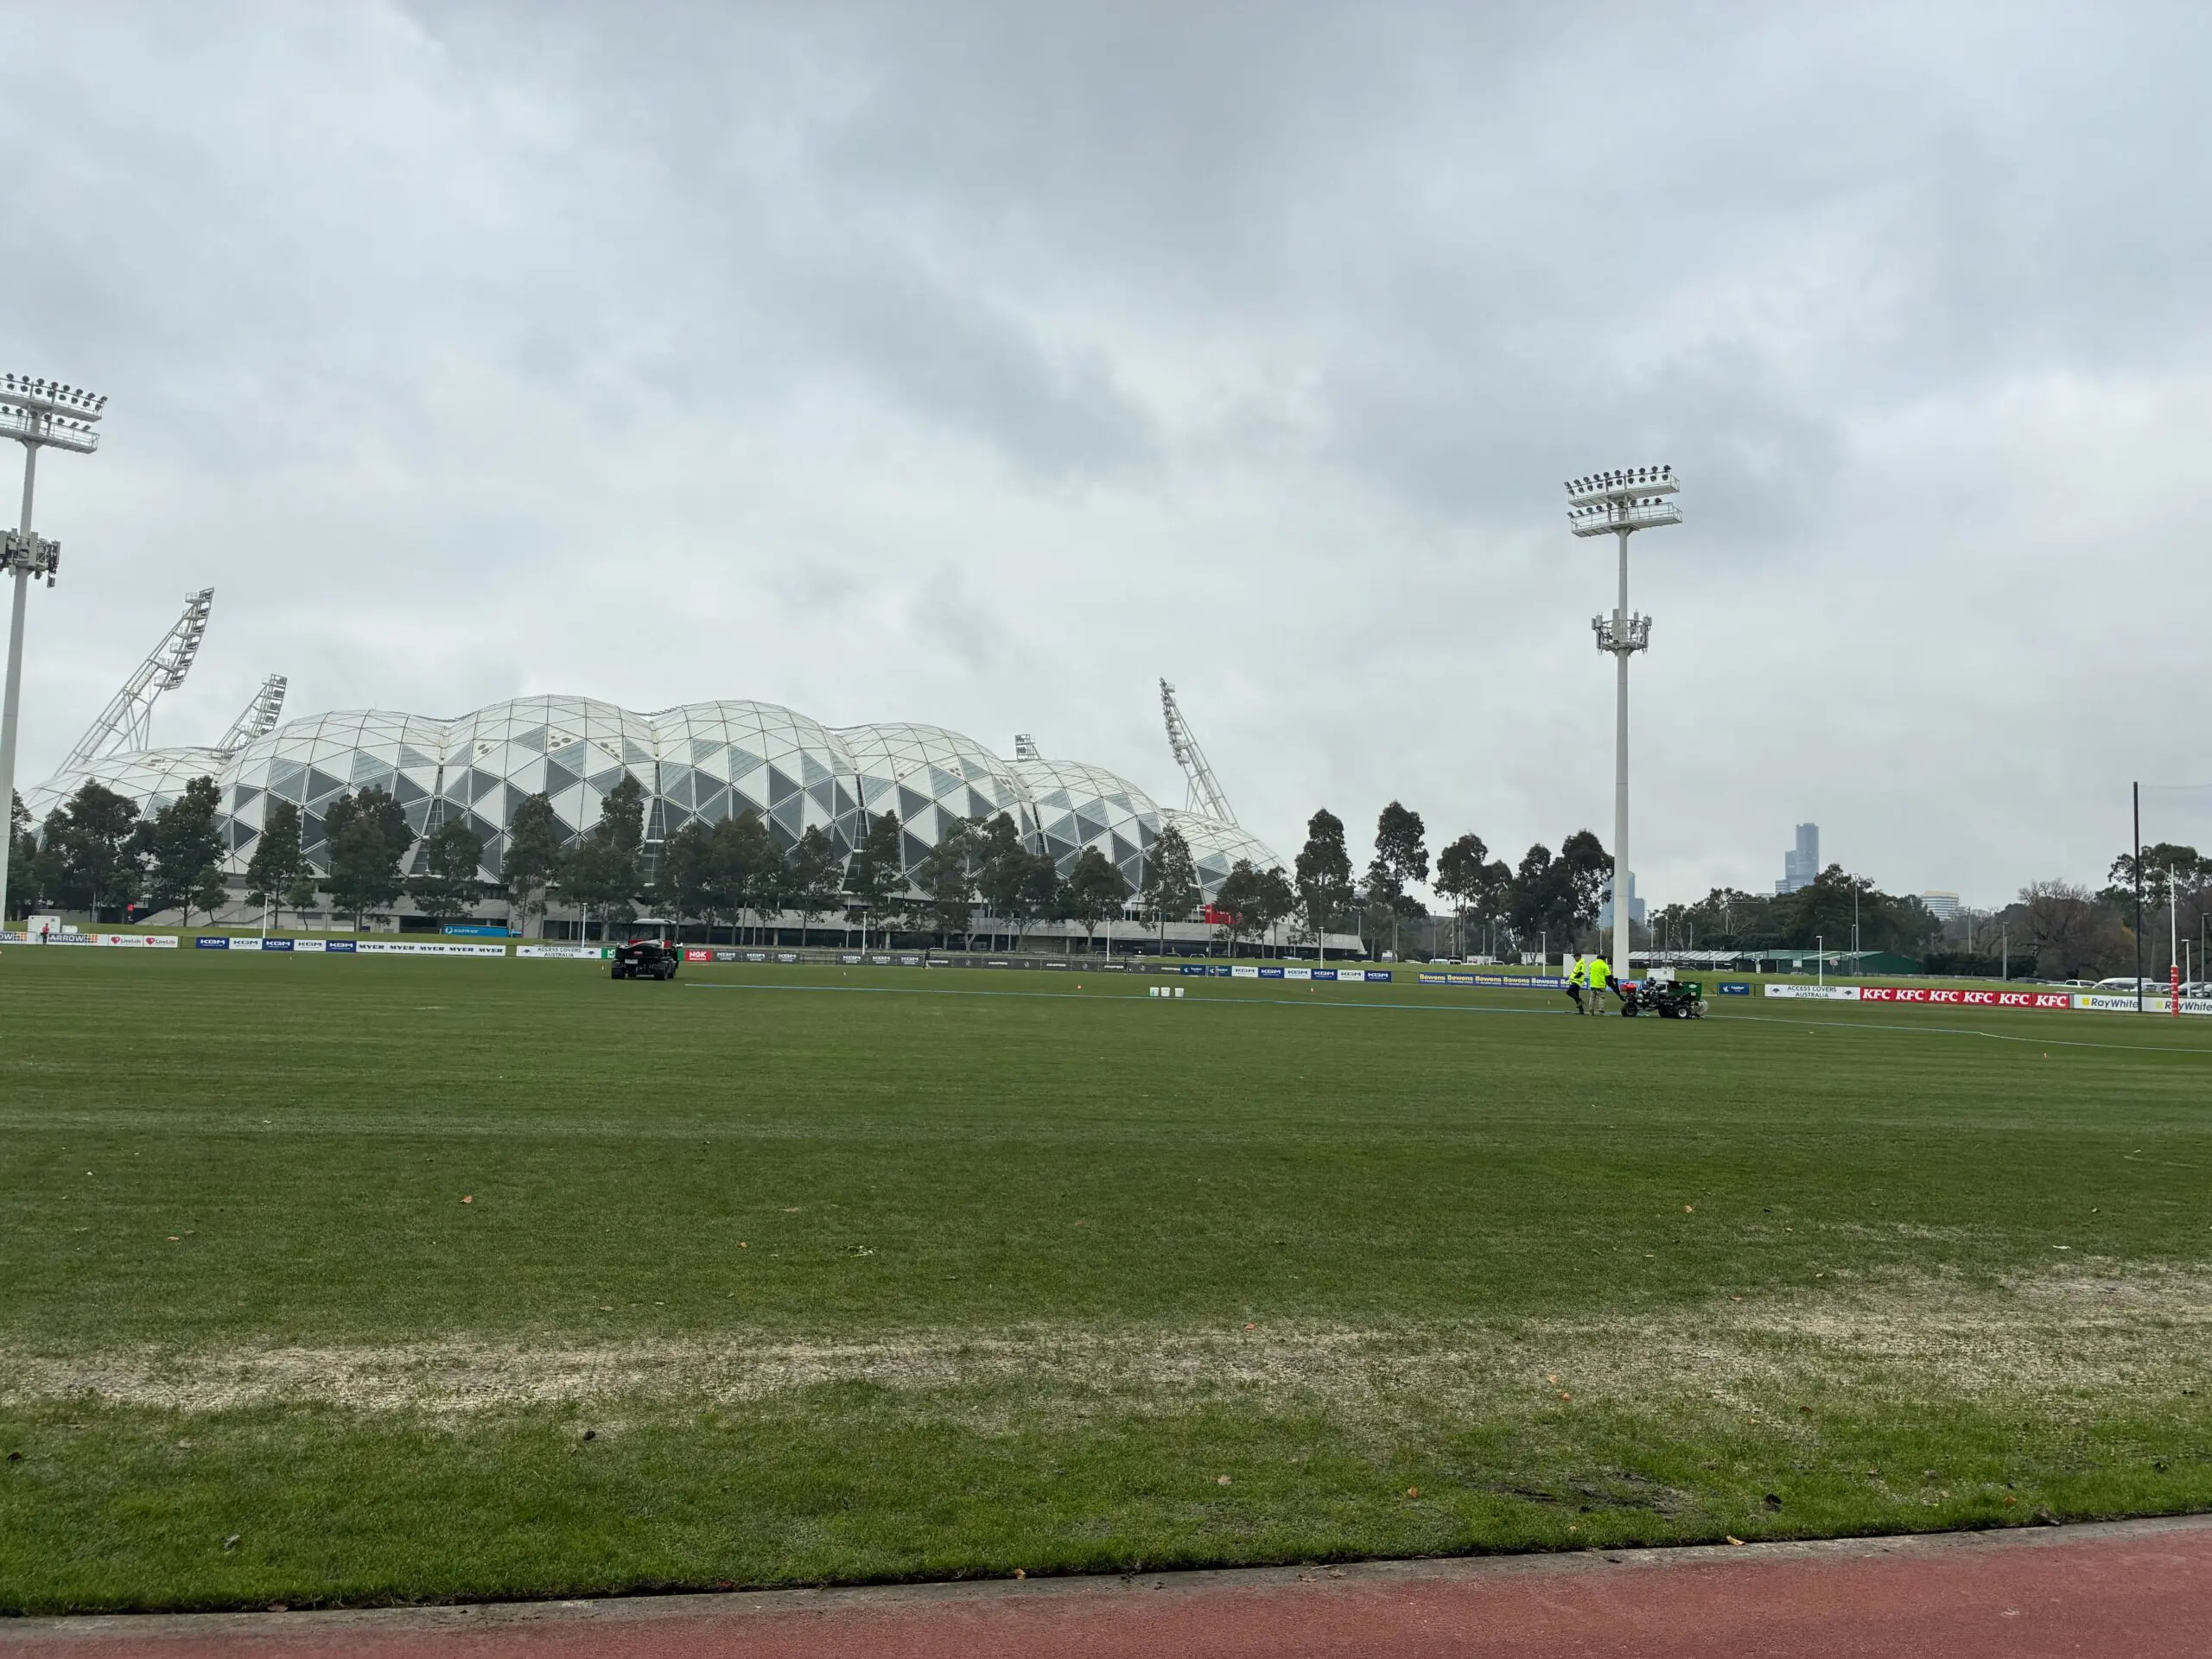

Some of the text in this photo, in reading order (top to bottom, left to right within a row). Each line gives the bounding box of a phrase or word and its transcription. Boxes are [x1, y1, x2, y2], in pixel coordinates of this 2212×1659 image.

[50, 934, 85, 943] ARROW
[1863, 988, 2068, 1007] KFC KFC KFC KFC KFC KFC
[2164, 1001, 2212, 1012] RyWhite
